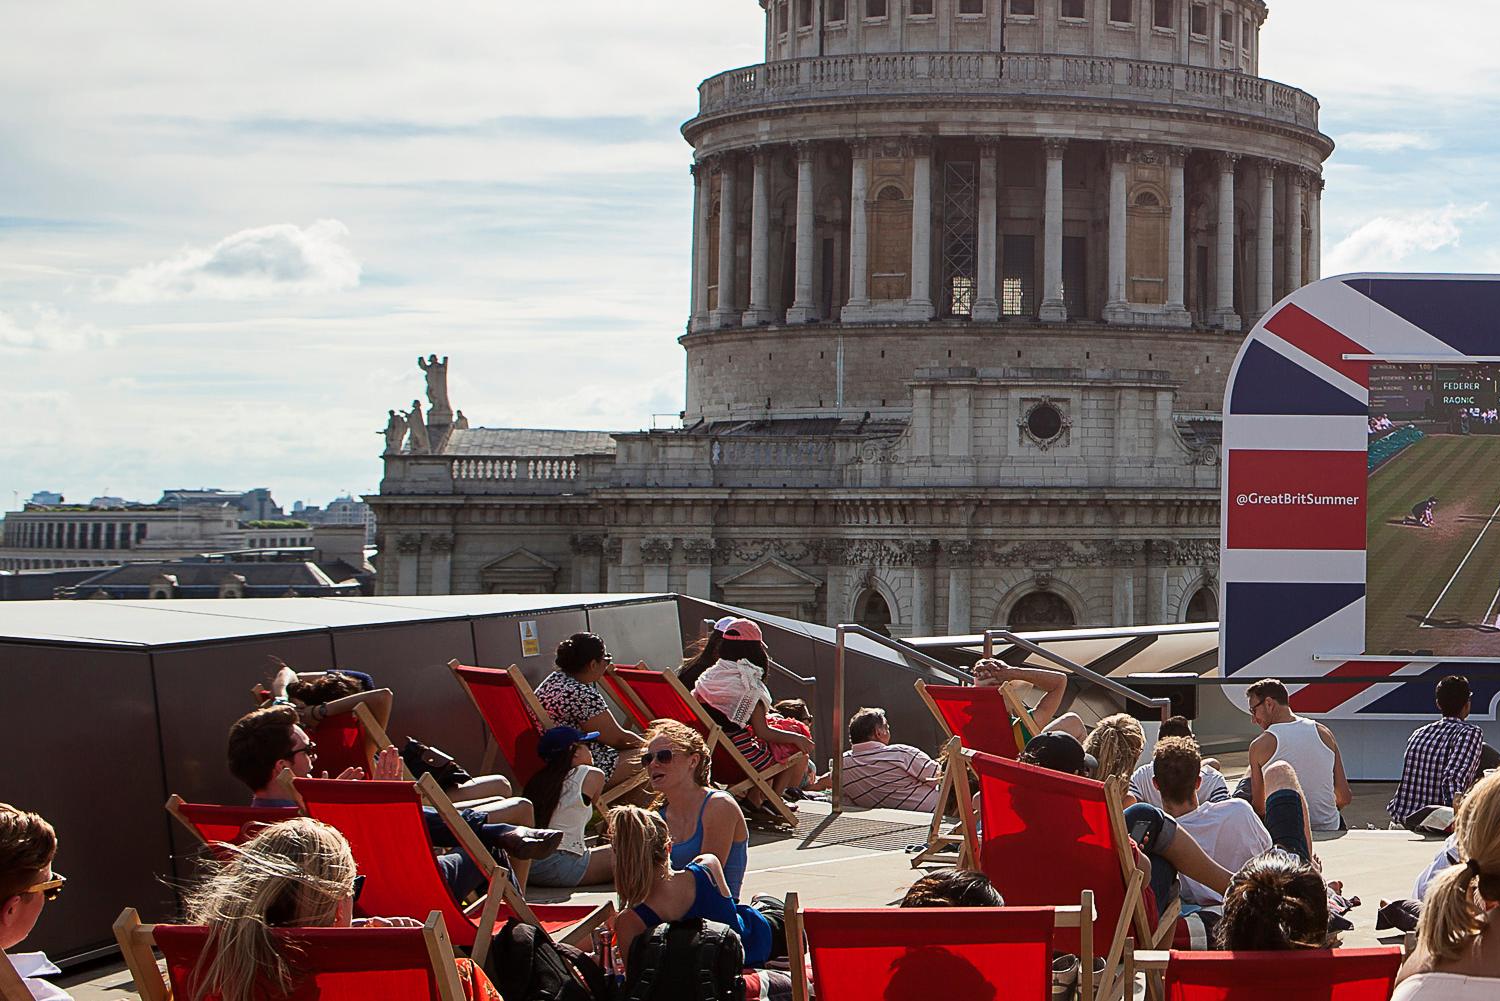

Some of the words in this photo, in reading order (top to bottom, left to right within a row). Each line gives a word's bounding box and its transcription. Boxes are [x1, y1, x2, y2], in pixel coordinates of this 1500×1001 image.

[1443, 382, 1480, 390] FEDERER
[1443, 396, 1475, 404] RAONIC
[1236, 492, 1359, 506] @GreatBritSummer
